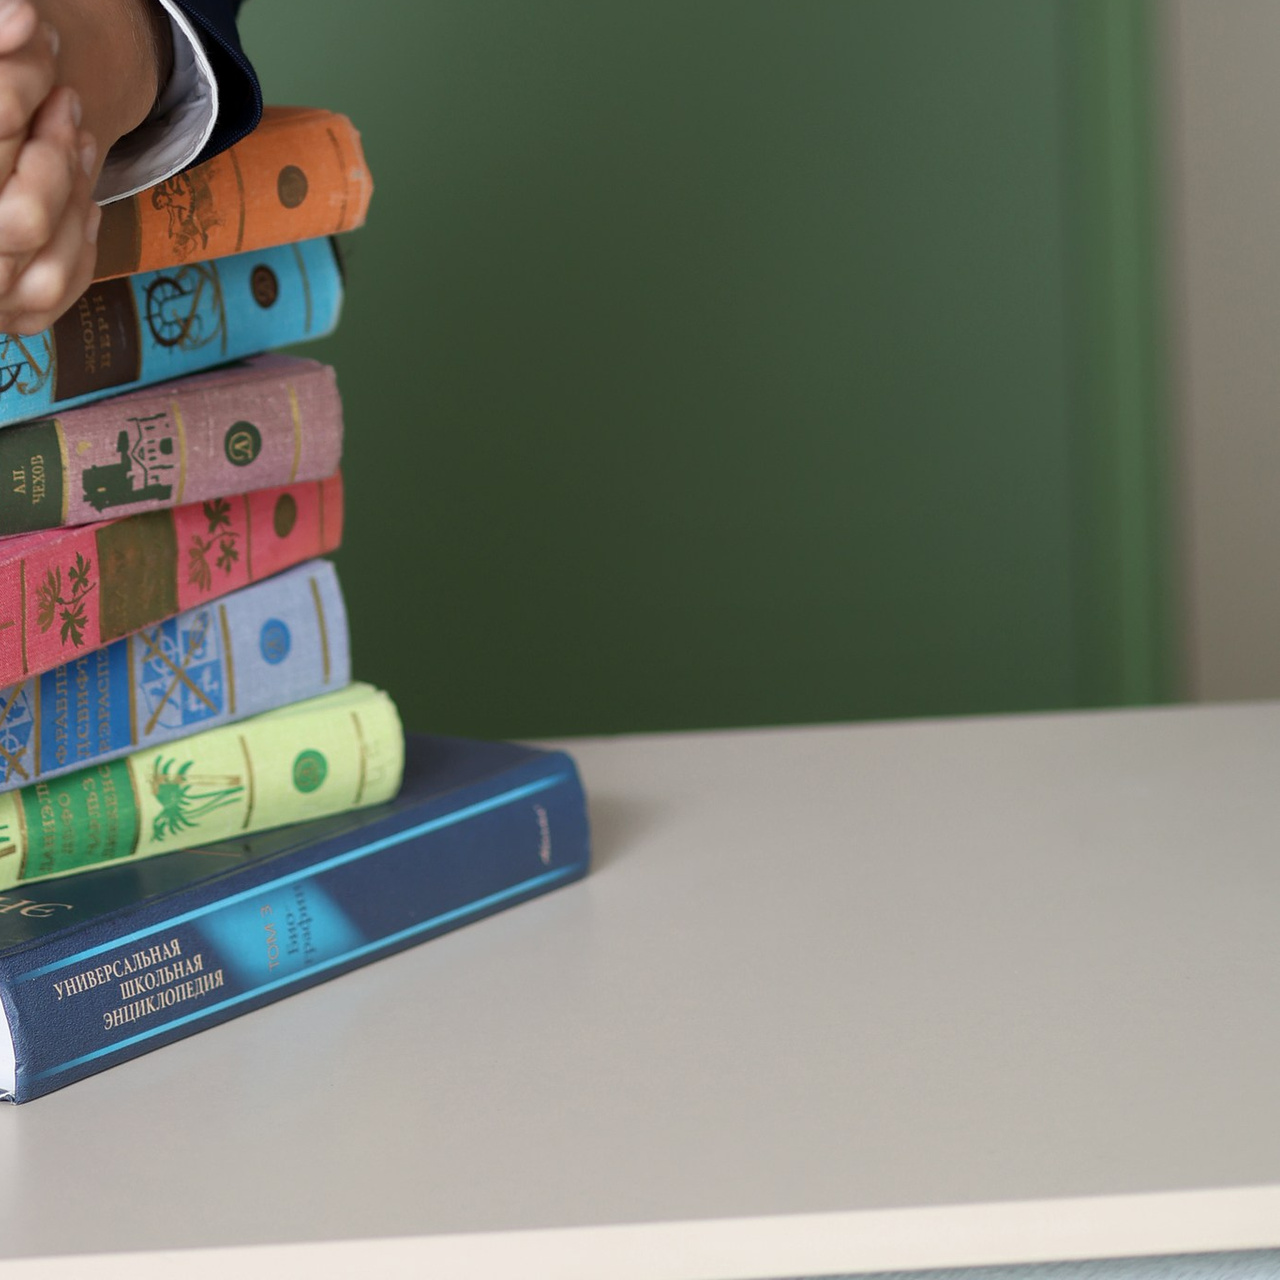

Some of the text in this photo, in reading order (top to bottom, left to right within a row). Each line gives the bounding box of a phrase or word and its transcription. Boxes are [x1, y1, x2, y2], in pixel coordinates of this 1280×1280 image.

[13, 465, 26, 495] А.П.
[31, 454, 46, 505] ЧЕХОВ
[260, 904, 280, 973] ТОМ 3
[53, 938, 181, 1001] УНИВЕРСАЛЬНАЯ
[120, 953, 204, 1000] ШКОЛЬНАЯ
[103, 969, 225, 1031] ЭНЦИКЛОПЕДИЯ
